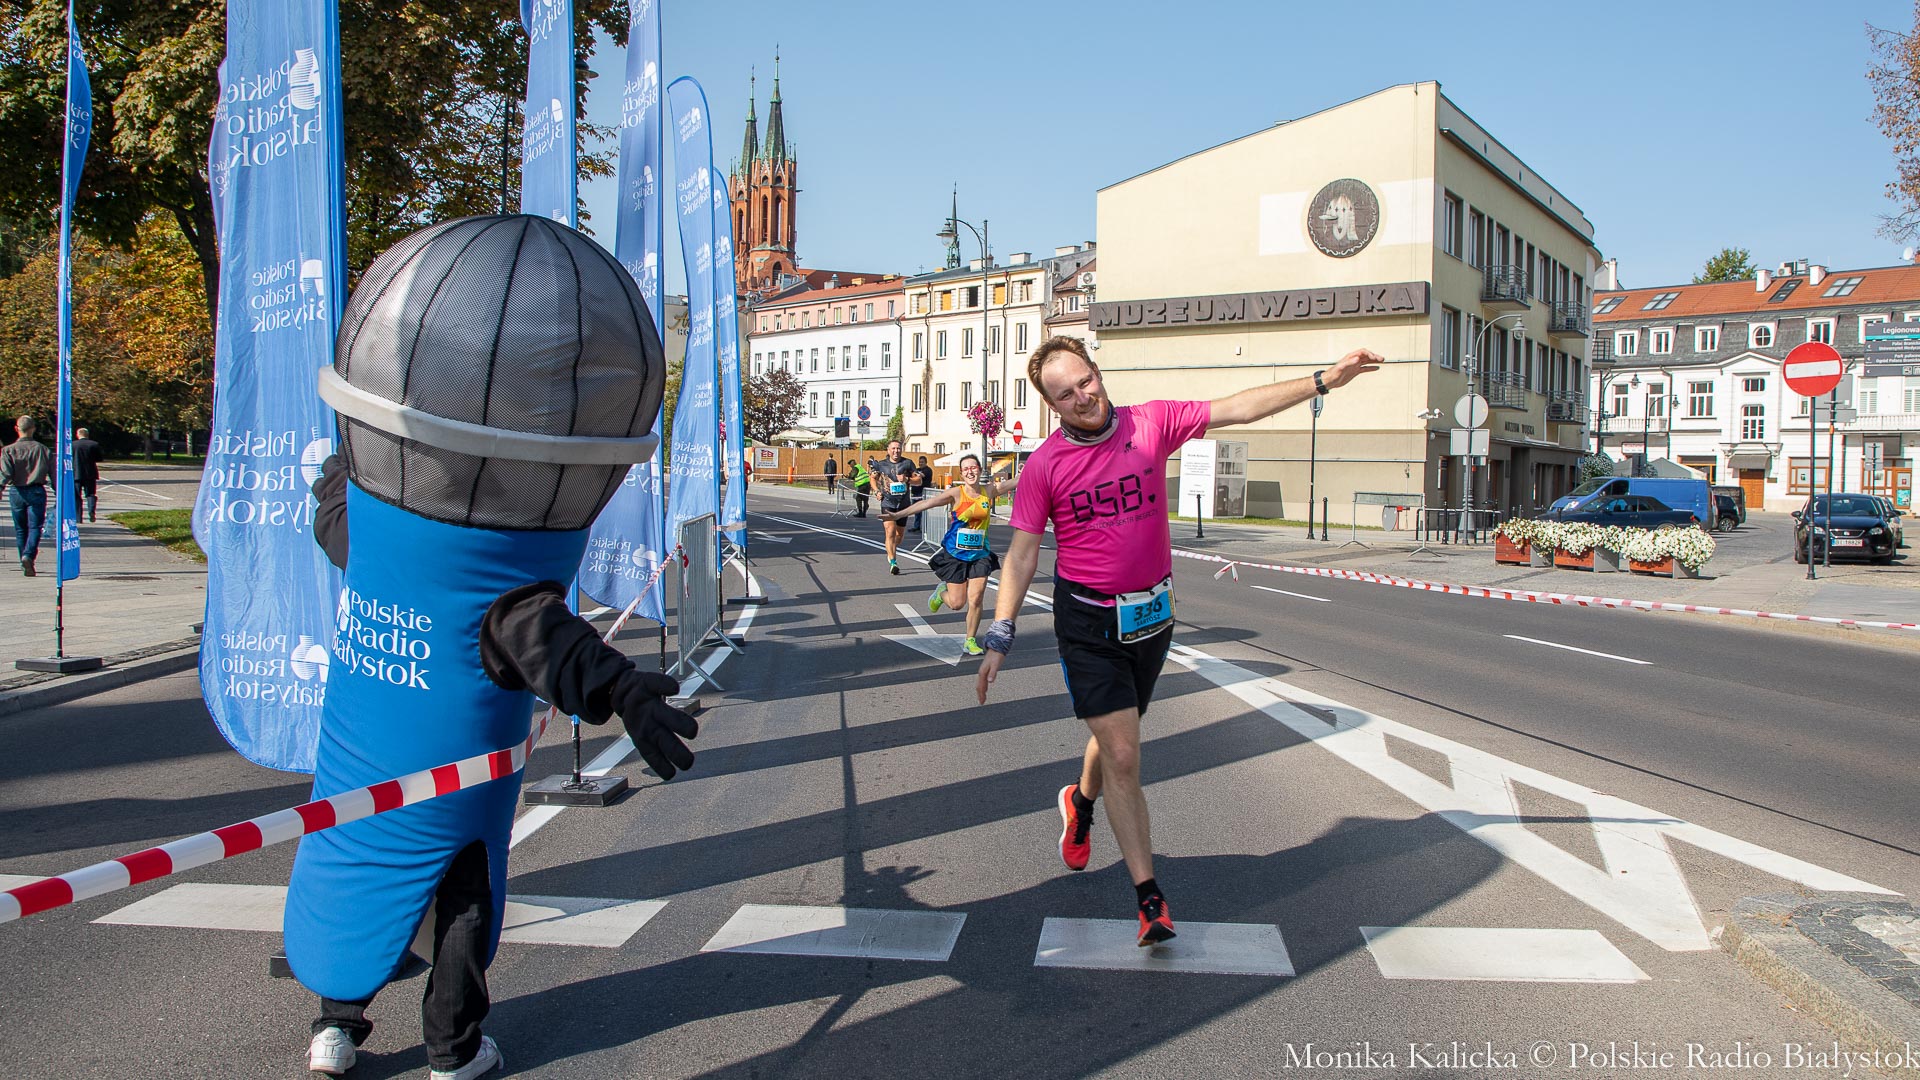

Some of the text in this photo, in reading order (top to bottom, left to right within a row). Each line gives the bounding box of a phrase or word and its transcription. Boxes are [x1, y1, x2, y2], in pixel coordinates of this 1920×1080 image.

[1096, 287, 1415, 328] MUZEUM WOJSKA
[963, 534, 980, 542] 380
[350, 590, 433, 632] Polskie
[1133, 596, 1163, 622] 336
[348, 614, 431, 660] Radio
